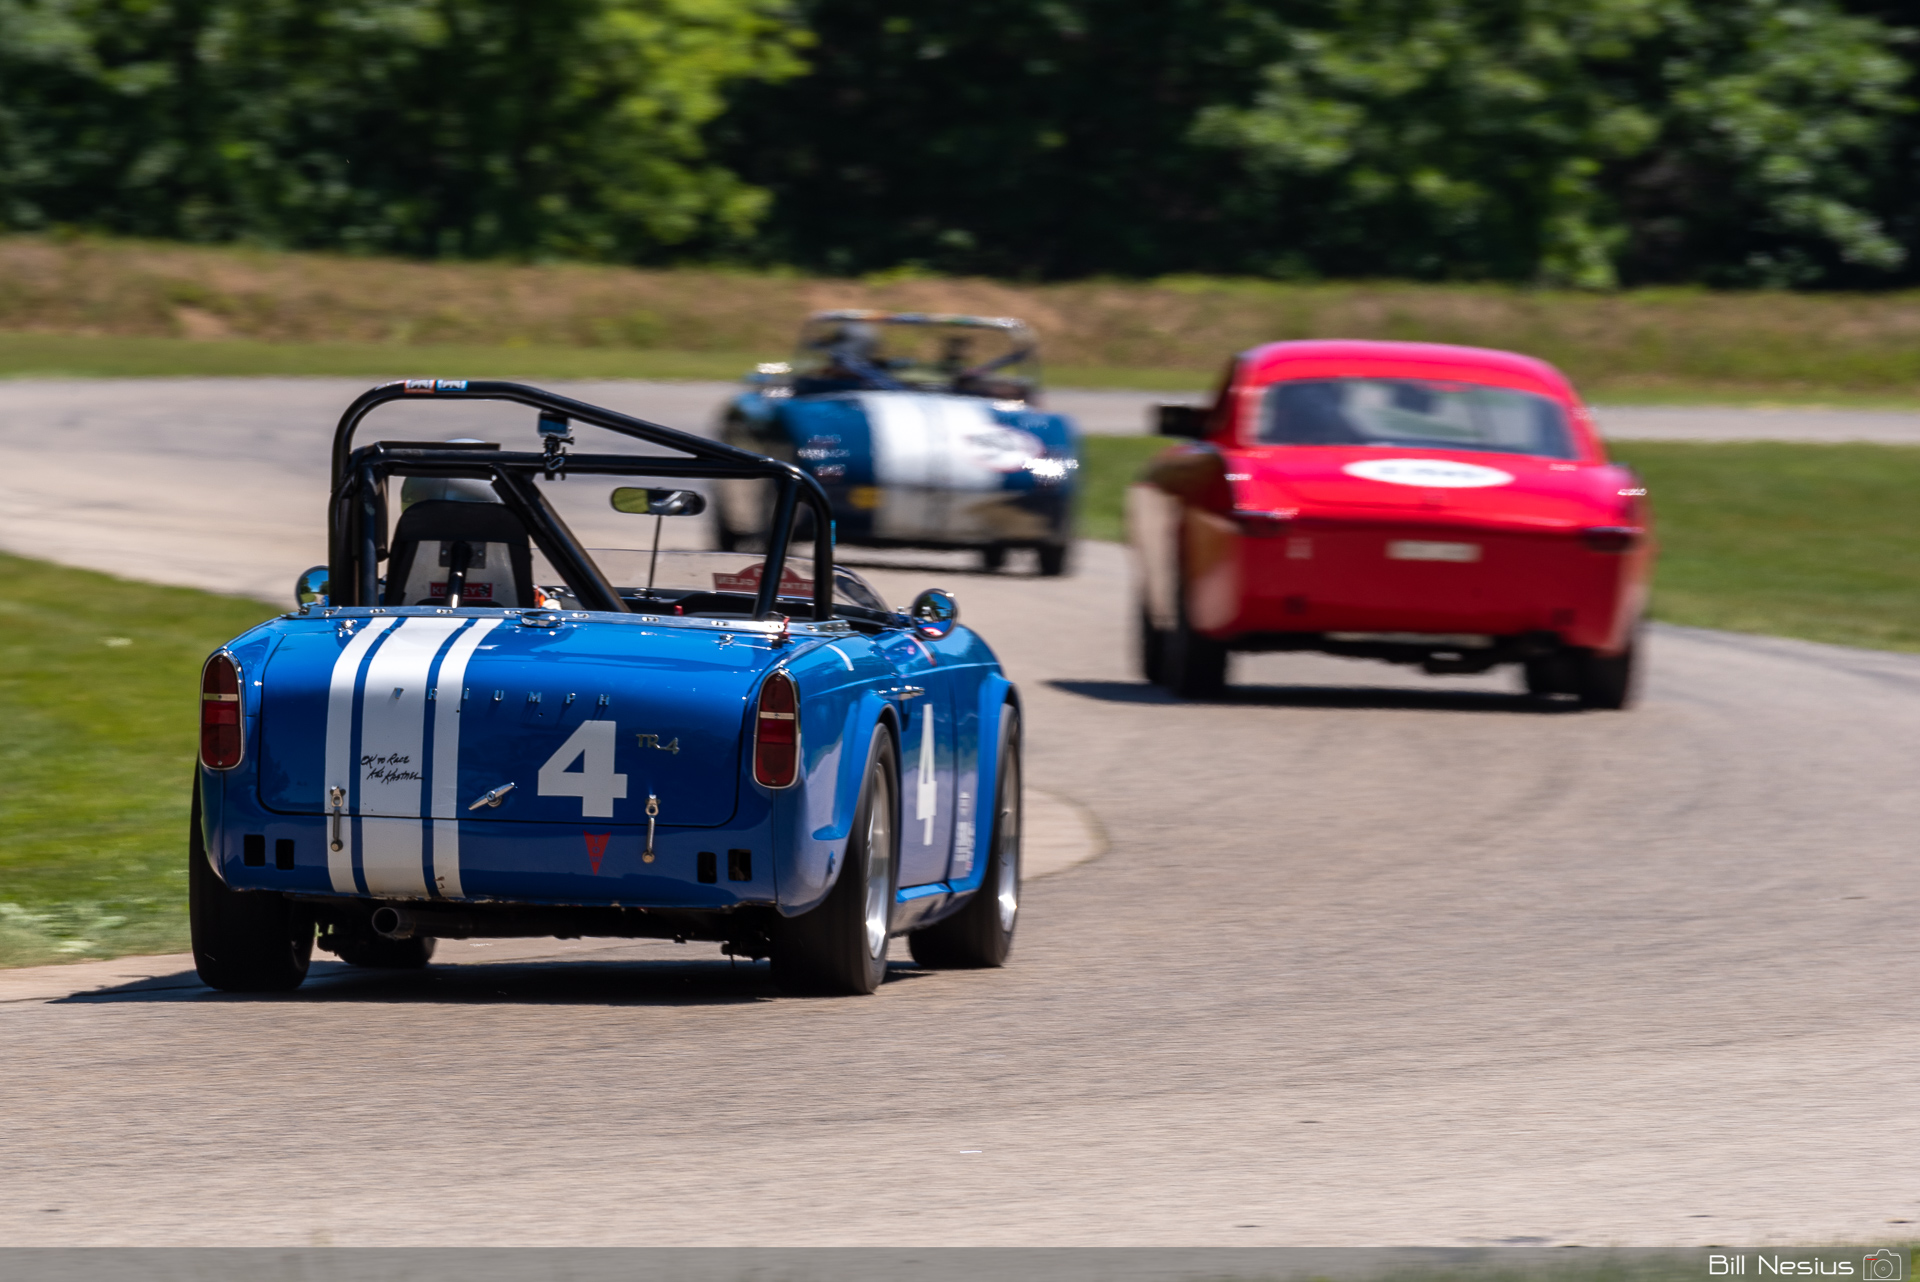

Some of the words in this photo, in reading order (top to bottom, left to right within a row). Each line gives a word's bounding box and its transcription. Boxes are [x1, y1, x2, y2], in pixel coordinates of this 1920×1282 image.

[393, 687, 610, 706] TRIUMPH
[537, 720, 628, 818] 4
[916, 703, 938, 846] 4
